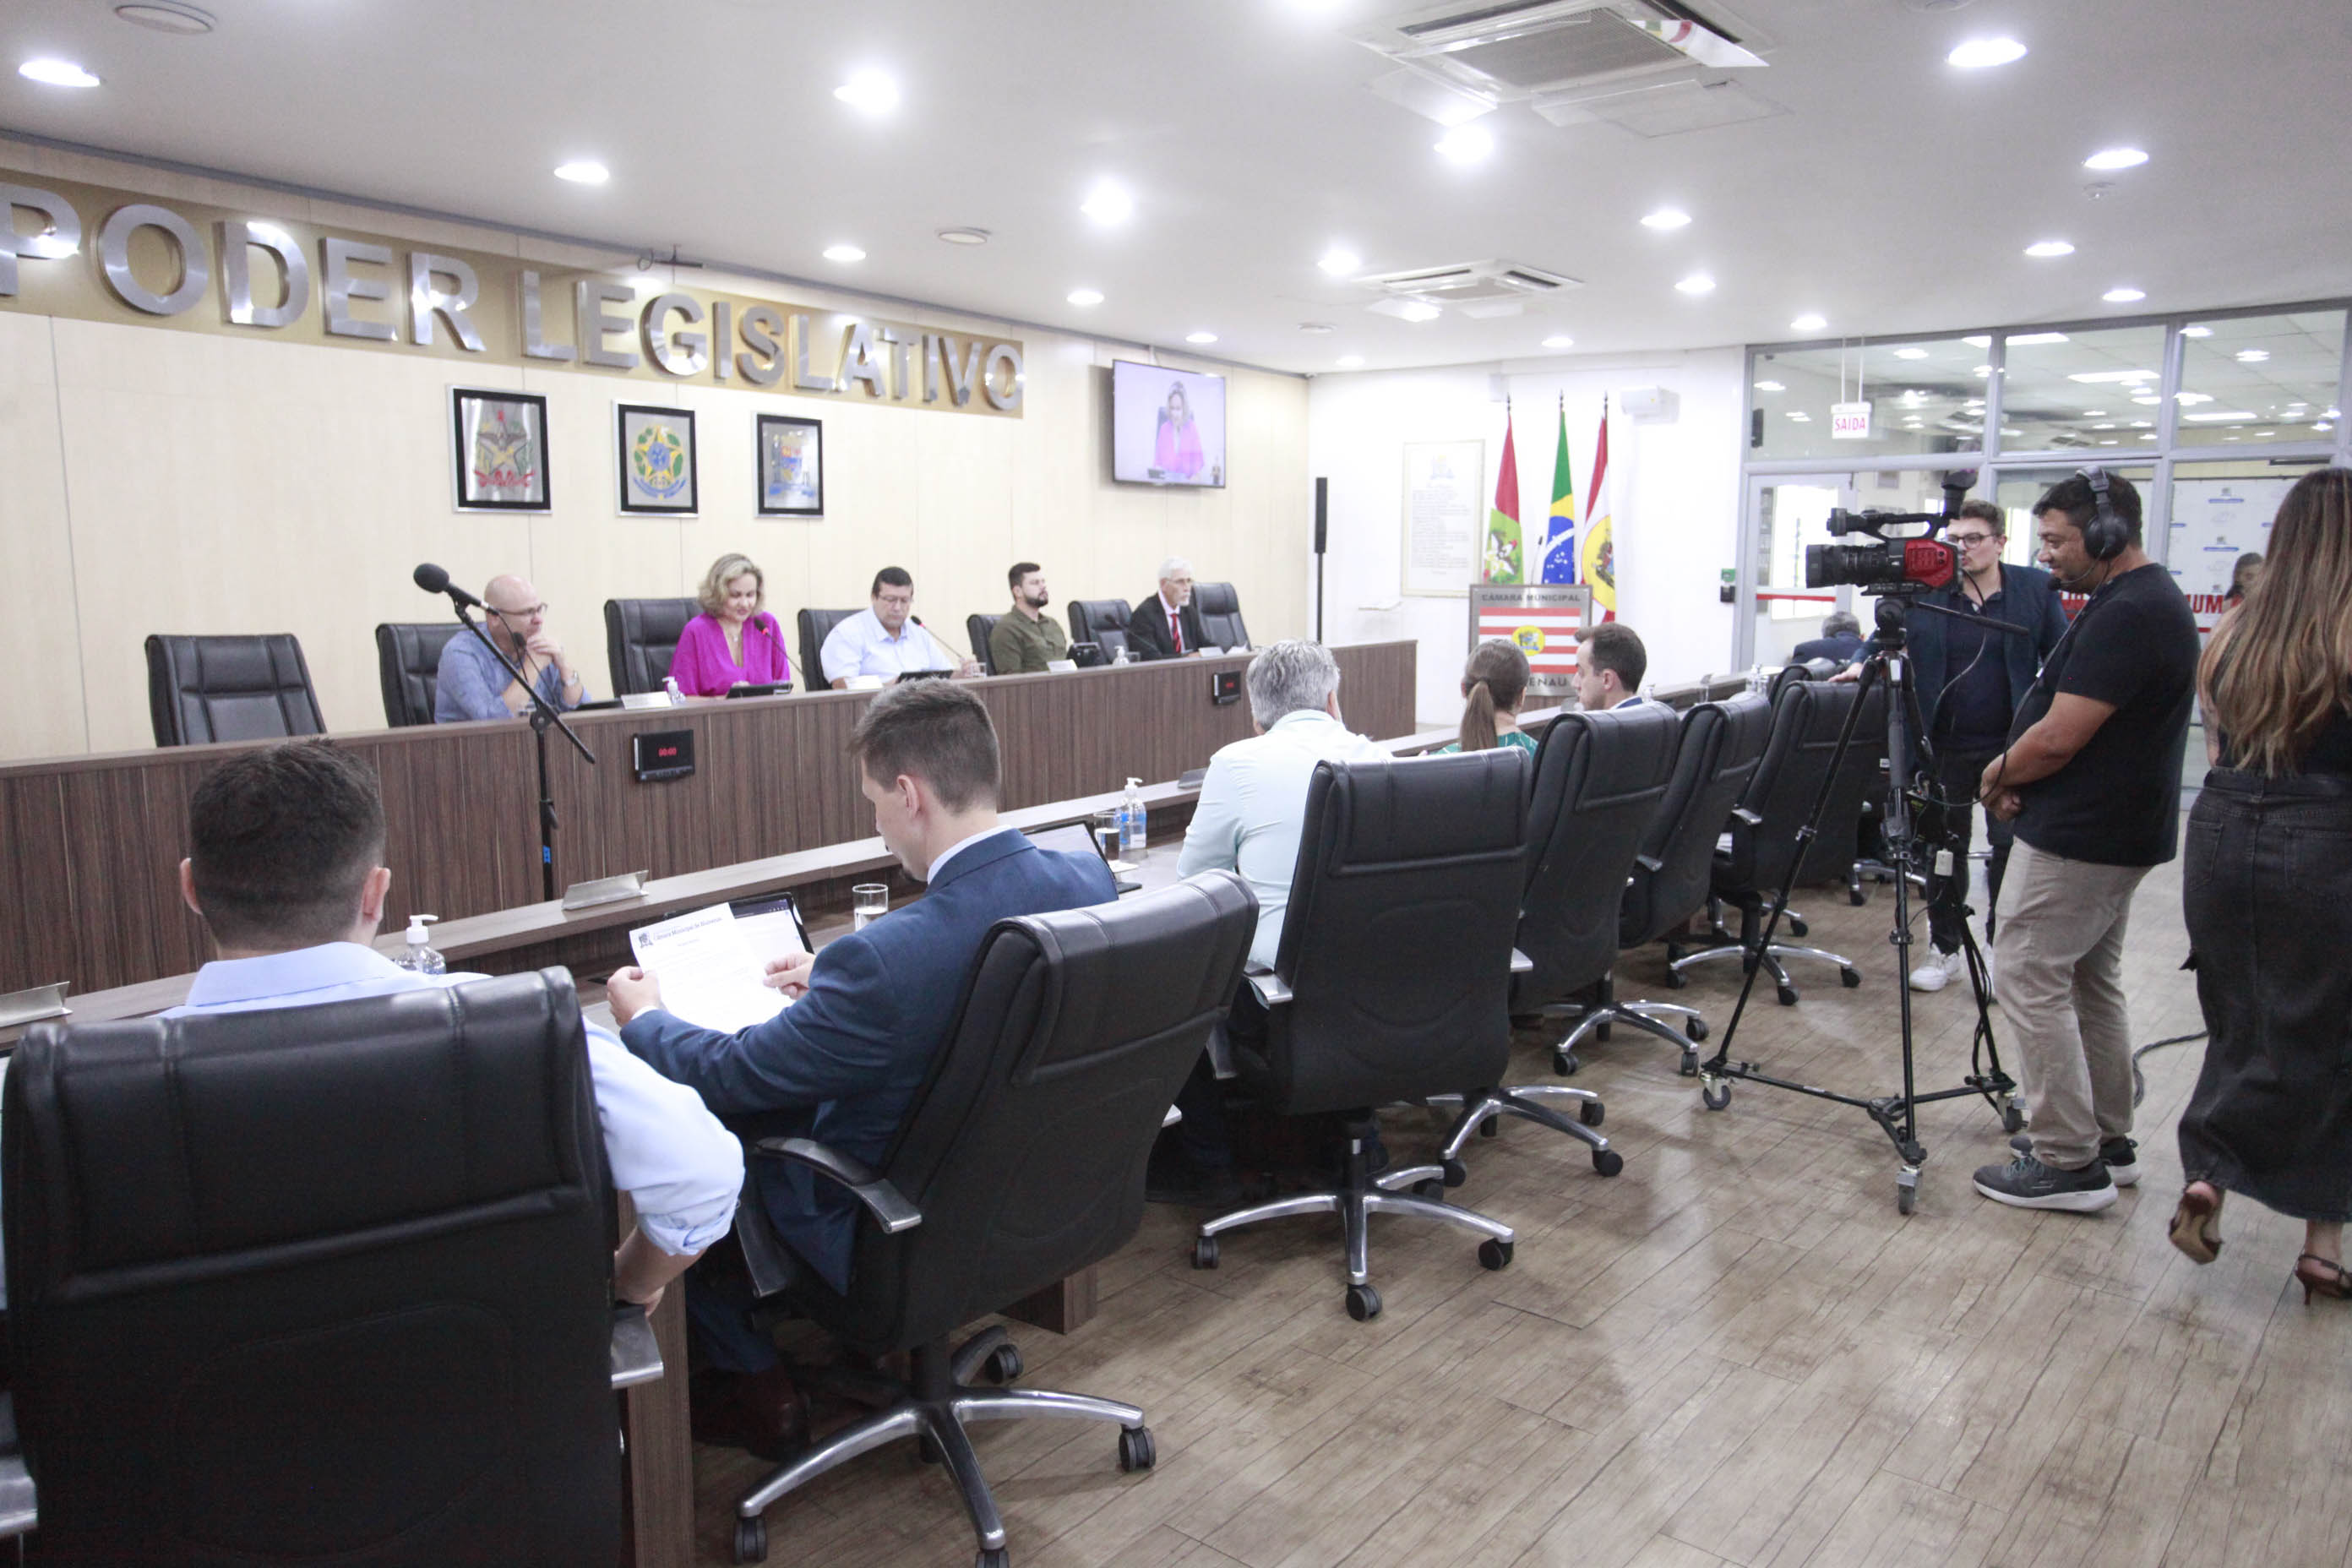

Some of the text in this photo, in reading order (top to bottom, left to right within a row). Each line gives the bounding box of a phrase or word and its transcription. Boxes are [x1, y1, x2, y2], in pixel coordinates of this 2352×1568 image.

[0, 182, 1025, 412] PODER LEGISLATIVO
[1526, 593, 1581, 602] MUNICIPAL
[1529, 677, 1567, 687] ENAU
